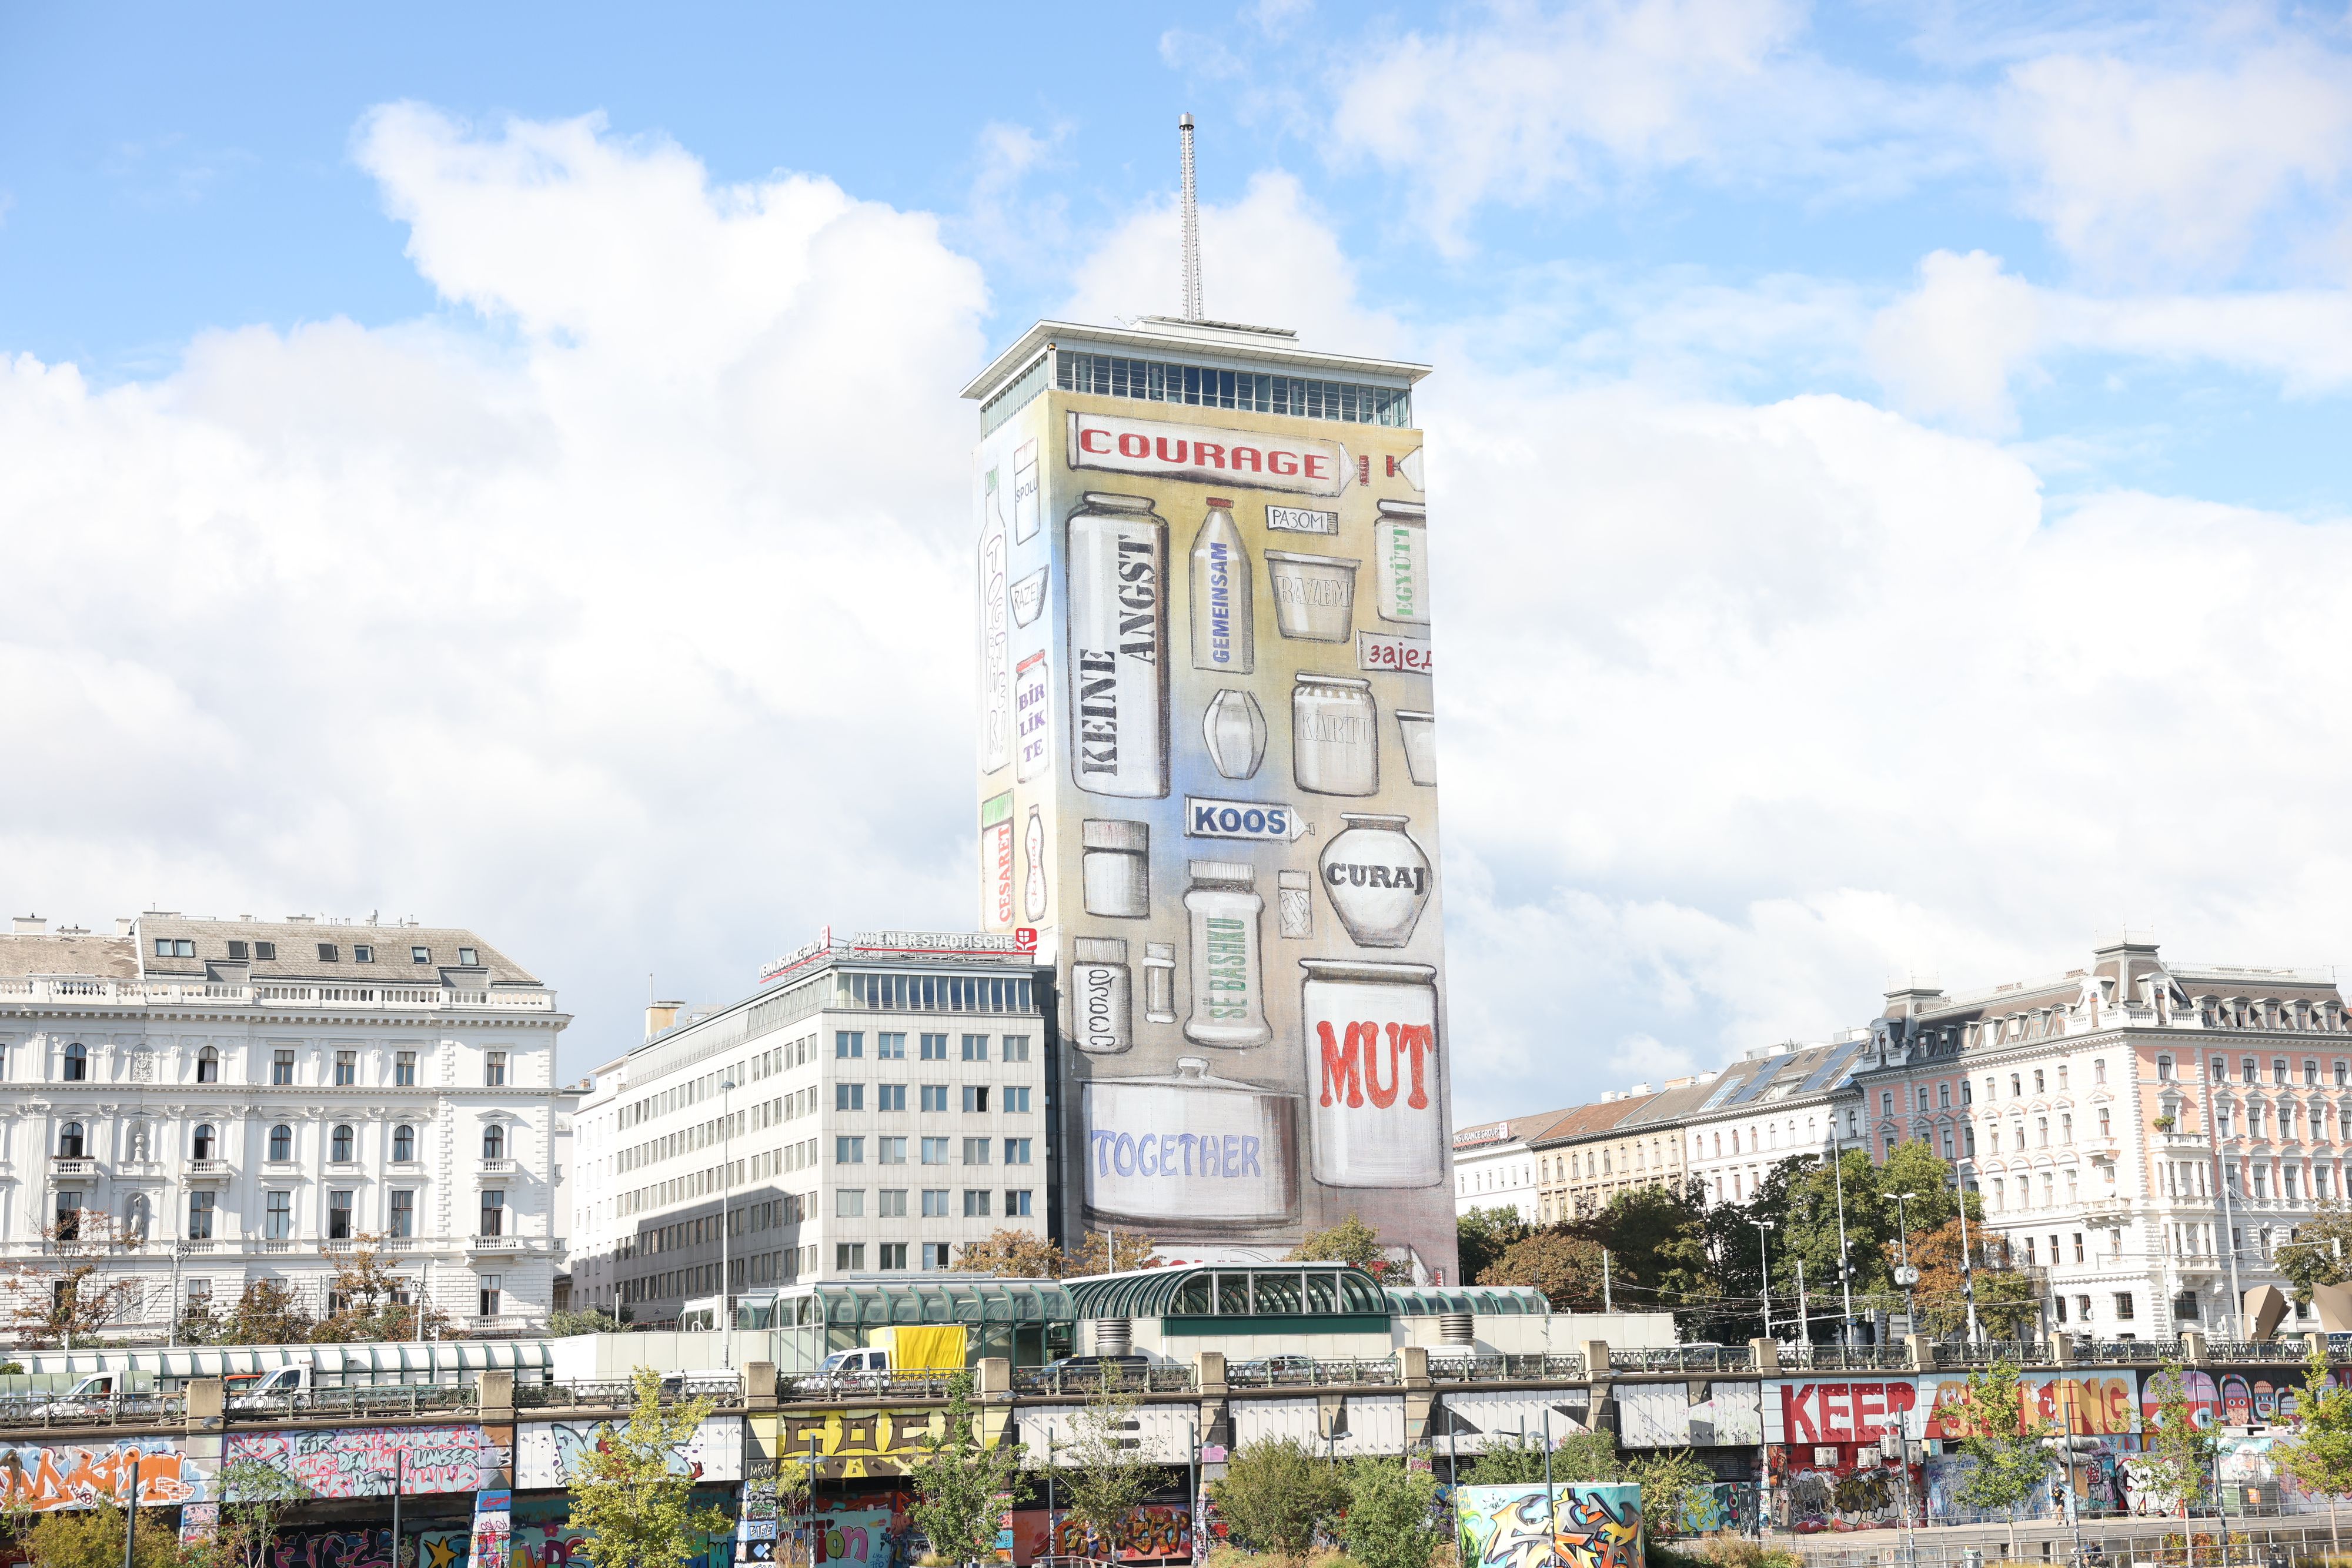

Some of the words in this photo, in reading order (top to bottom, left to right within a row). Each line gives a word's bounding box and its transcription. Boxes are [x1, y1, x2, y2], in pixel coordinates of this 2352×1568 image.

[1080, 428, 1329, 480] COURAGE
[1016, 475, 1038, 503] SPOLU
[1389, 524, 1414, 616] EGYÜTT
[1210, 542, 1230, 664] GEMEINSAM
[1275, 576, 1350, 607] RAZEM
[1080, 648, 1118, 776] KEINE
[1118, 534, 1155, 666] ANGST
[1296, 712, 1371, 744] KARTU
[1023, 738, 1044, 763] TE
[1195, 806, 1287, 834] KOOS
[998, 826, 1011, 922] CESARET
[1327, 862, 1425, 895] CURAJ
[759, 959, 777, 978] VIENNA
[777, 947, 804, 973] INSURANCE
[803, 939, 821, 958] GROUP
[854, 932, 917, 946] WIENER
[921, 934, 1015, 949] STÄDTISCHE
[1207, 918, 1247, 991] BASHKU
[1317, 1021, 1432, 1109] MUT
[1091, 1130, 1261, 1177] TOGETHER
[1453, 1129, 1481, 1143] INSURANCE
[1481, 1128, 1499, 1138] GROUP
[1781, 1382, 1916, 1443] KEEP
[749, 1523, 773, 1537] LIFE
